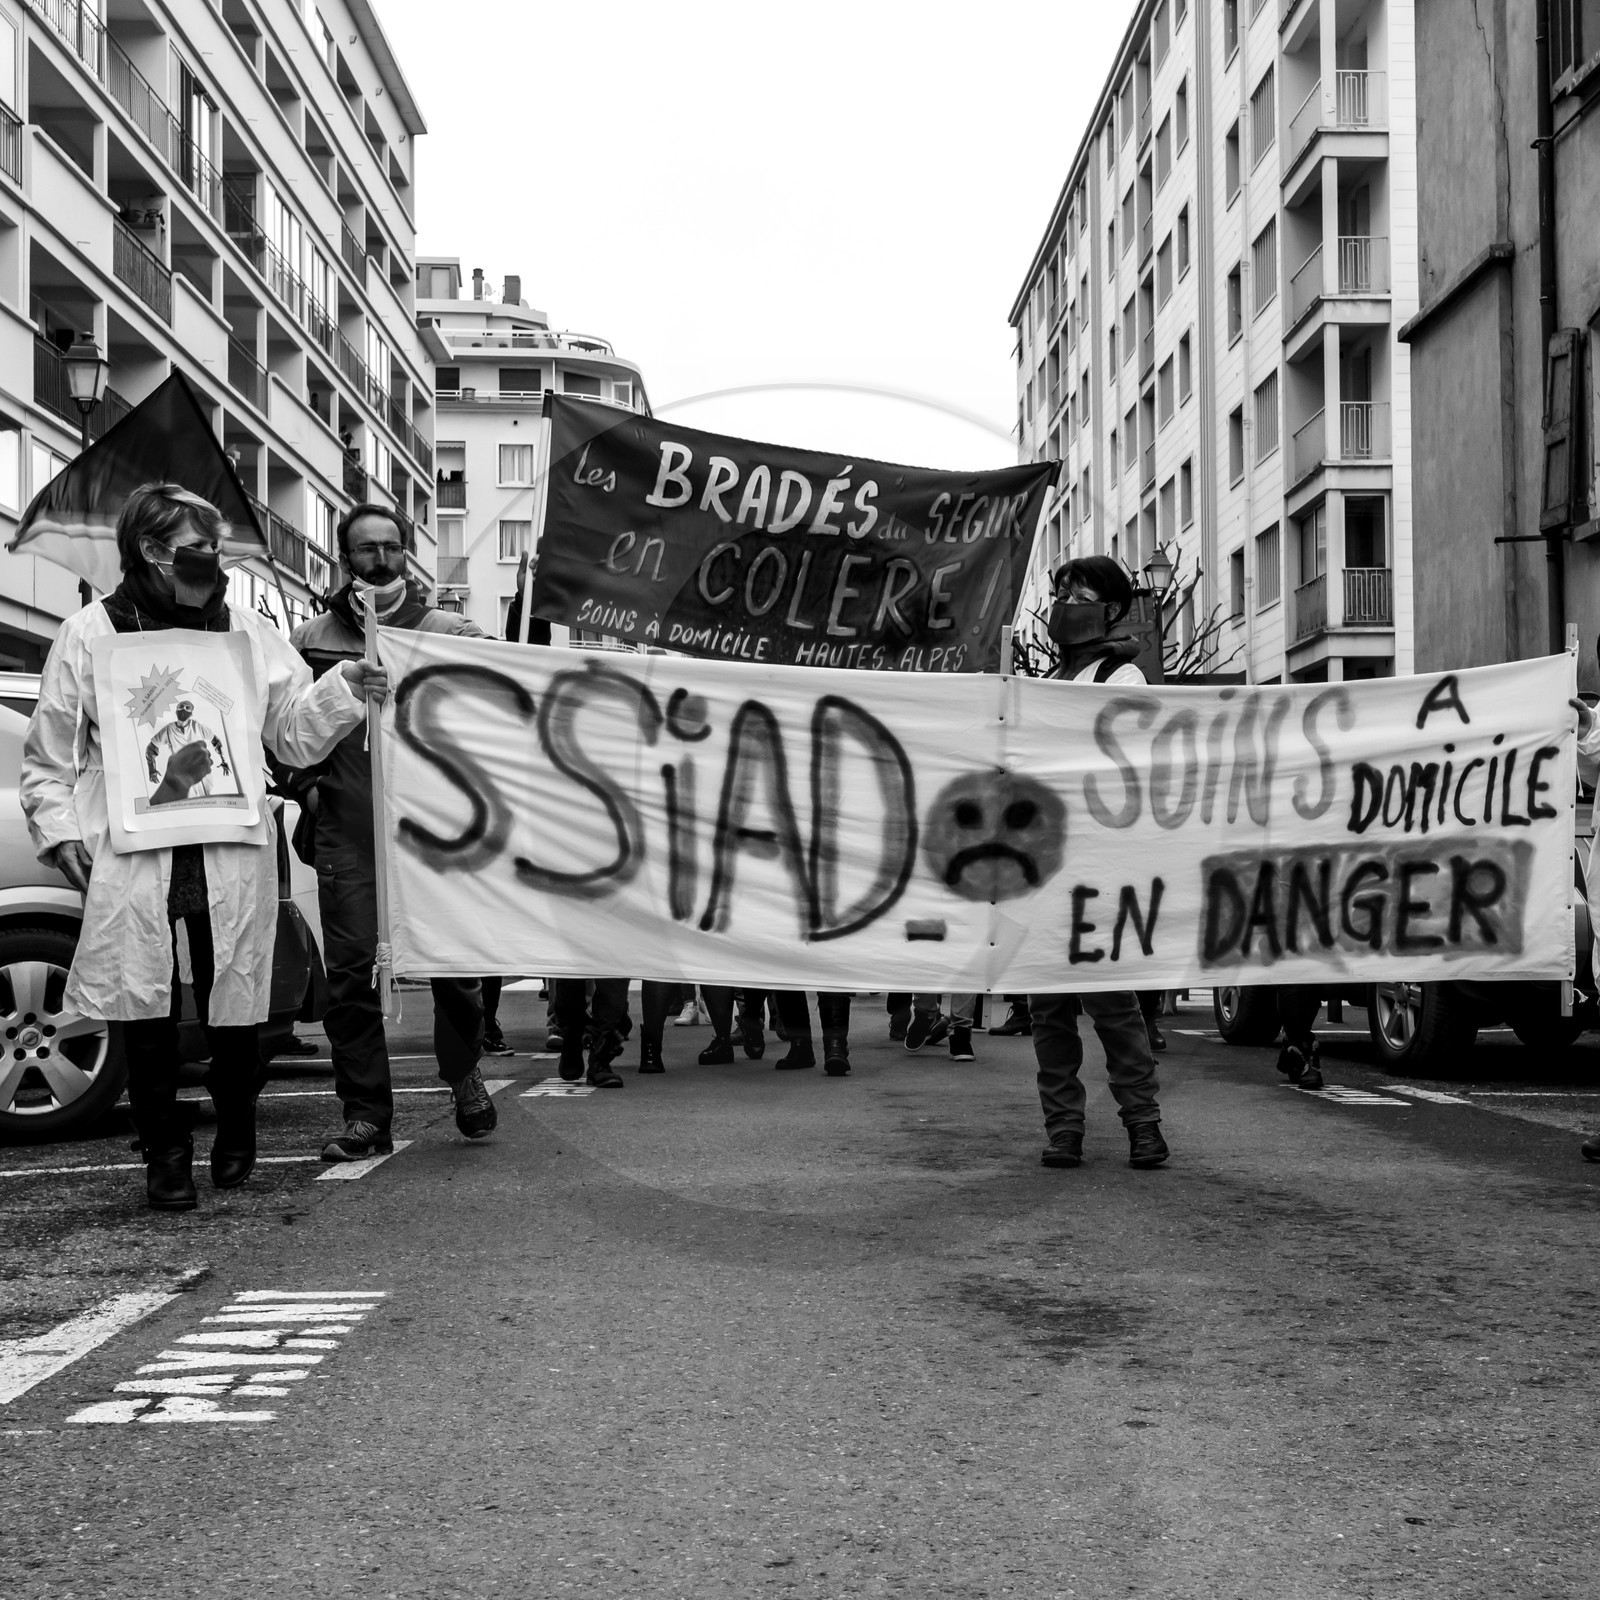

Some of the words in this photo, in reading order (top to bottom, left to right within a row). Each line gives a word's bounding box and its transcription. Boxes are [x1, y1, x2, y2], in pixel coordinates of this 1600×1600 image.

[878, 512, 910, 541] du
[597, 531, 666, 582] en
[1416, 675, 1470, 729] A
[1069, 877, 1165, 964] EN
[1203, 856, 1507, 962] DANGER
[65, 1288, 388, 1424] PAYANT
